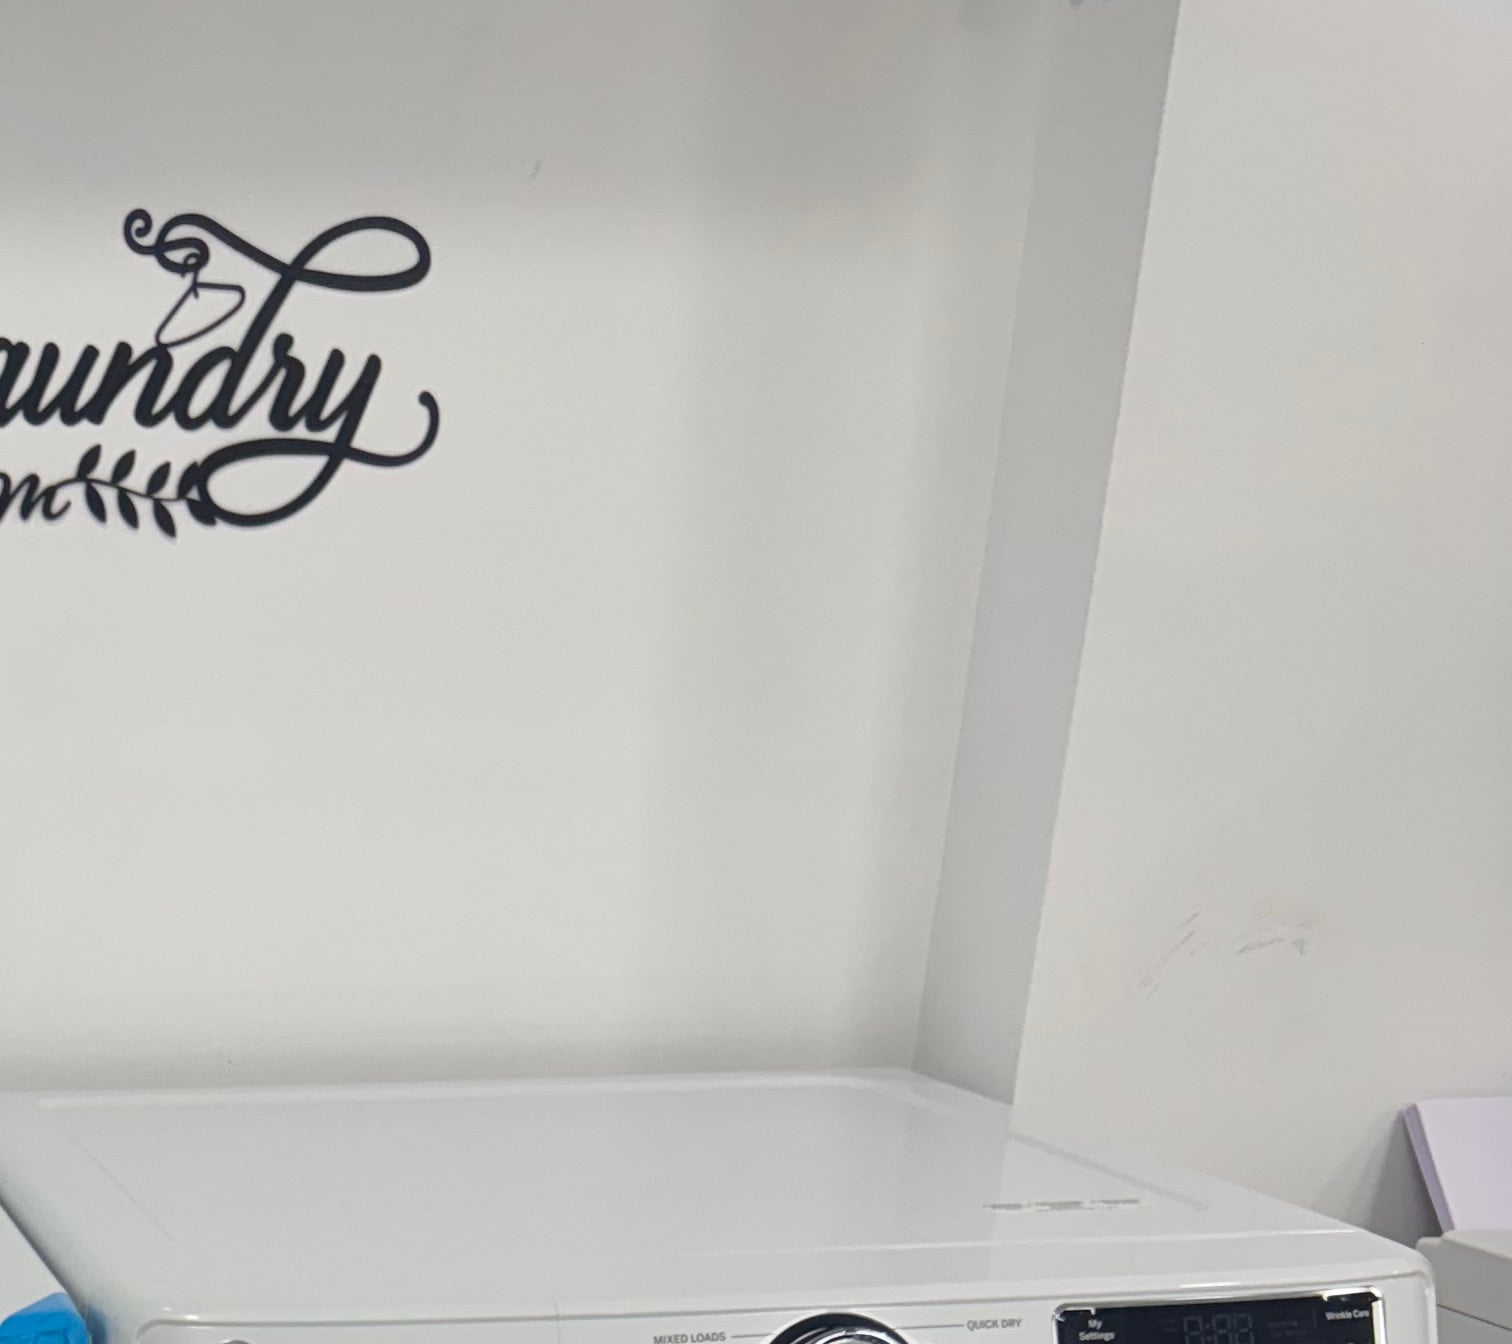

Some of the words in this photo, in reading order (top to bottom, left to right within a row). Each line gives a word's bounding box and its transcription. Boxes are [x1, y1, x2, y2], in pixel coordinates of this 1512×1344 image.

[1325, 1310, 1352, 1320] Wrinkle
[1352, 1309, 1370, 1318] Care
[966, 1320, 999, 1332] QUICK
[1001, 1319, 1022, 1329] DRY
[1088, 1319, 1103, 1330] My
[653, 1334, 688, 1344] MIXED
[690, 1332, 726, 1343] LOADS
[1078, 1331, 1116, 1342] Settings
